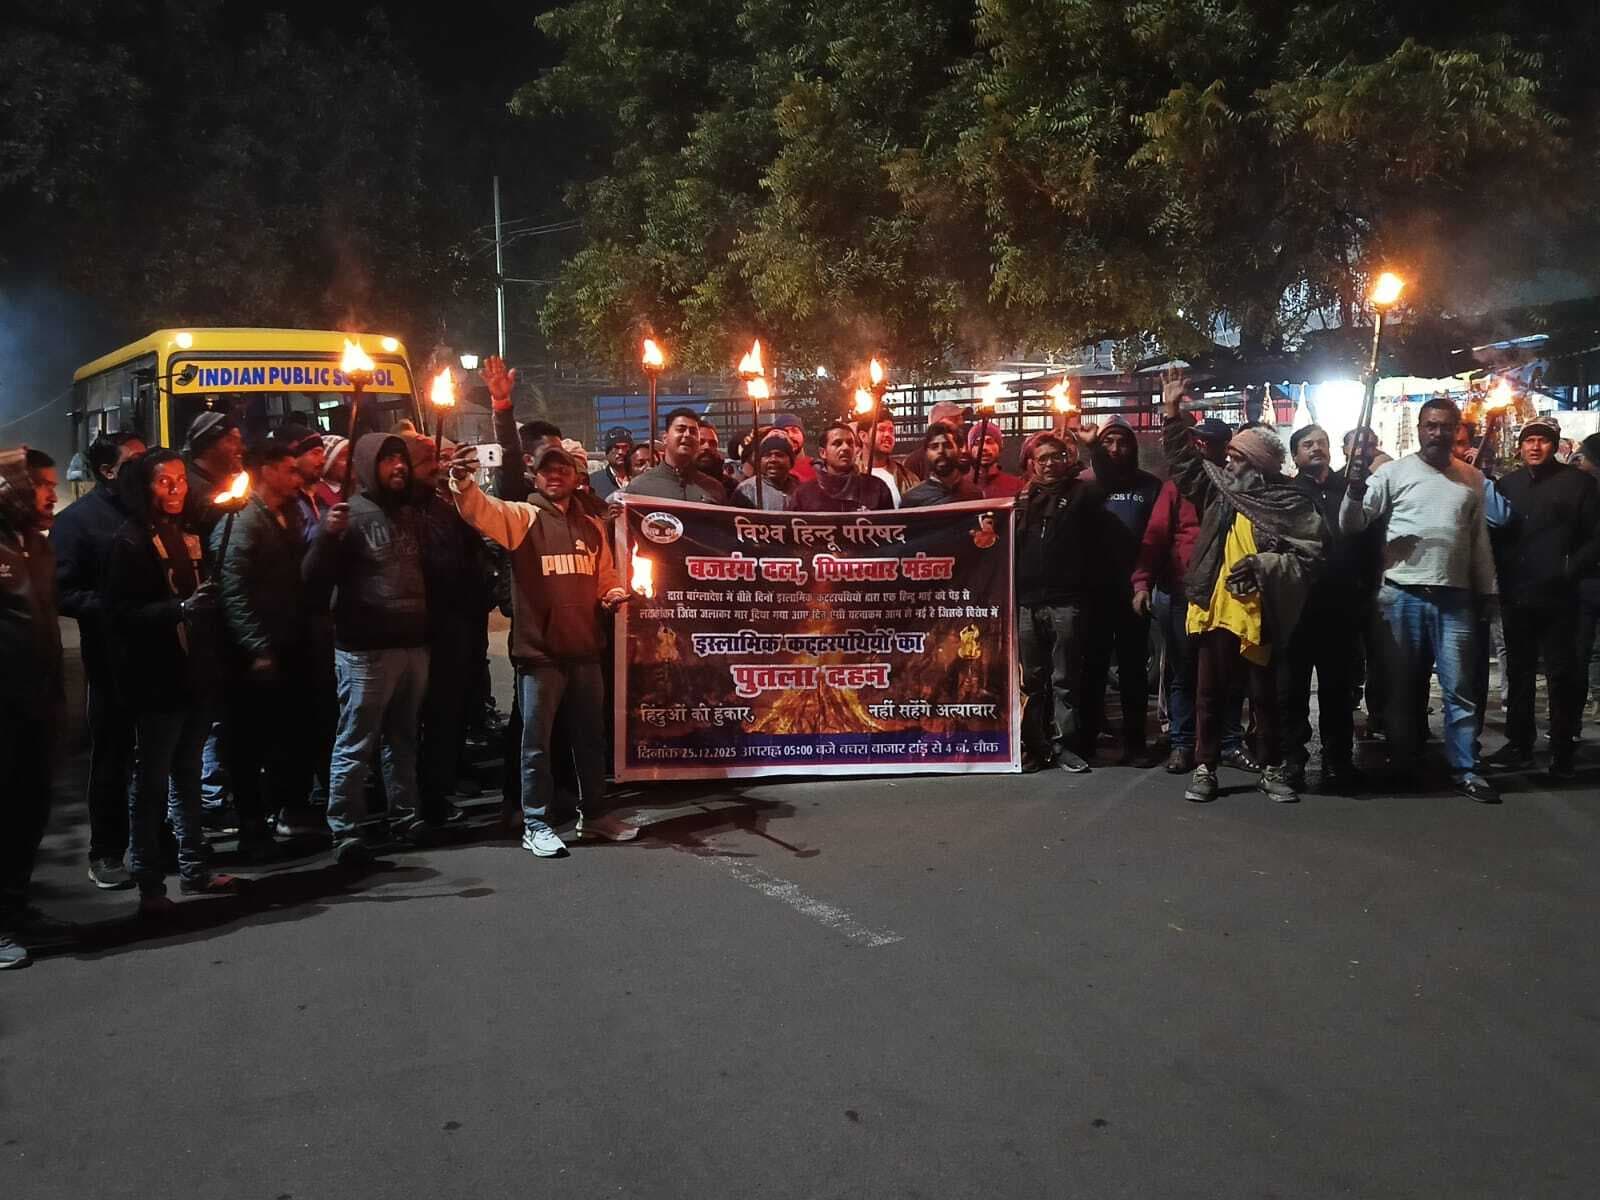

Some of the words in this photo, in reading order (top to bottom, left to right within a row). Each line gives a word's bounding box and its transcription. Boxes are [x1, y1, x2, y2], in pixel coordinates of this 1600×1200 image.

[199, 367, 265, 386] INDIAN
[269, 366, 330, 386] PUBLIC
[735, 516, 786, 544] विश्व
[792, 517, 841, 552] हिन्दू
[843, 517, 907, 547] परिषद
[686, 551, 757, 582] बजरंग
[759, 555, 808, 586] दल,
[812, 553, 898, 582] पिपरवार
[900, 551, 955, 581] मंडल
[726, 589, 734, 602] में
[962, 587, 971, 601] से
[991, 604, 999, 618] में
[692, 630, 782, 657] इस्लामिक
[895, 631, 926, 654] का
[732, 664, 818, 698] पुतला
[823, 663, 891, 689] दहन
[640, 703, 687, 727] हिंदुओं
[691, 702, 712, 721] की
[868, 698, 895, 719] नहीं
[898, 698, 933, 719] सहेंगे
[936, 702, 998, 719] अत्याचार
[638, 744, 681, 760] दिनांक
[682, 746, 737, 759] 25.12.2025
[784, 744, 813, 756] 05:00
[931, 739, 942, 753] से
[945, 744, 952, 753] 4
